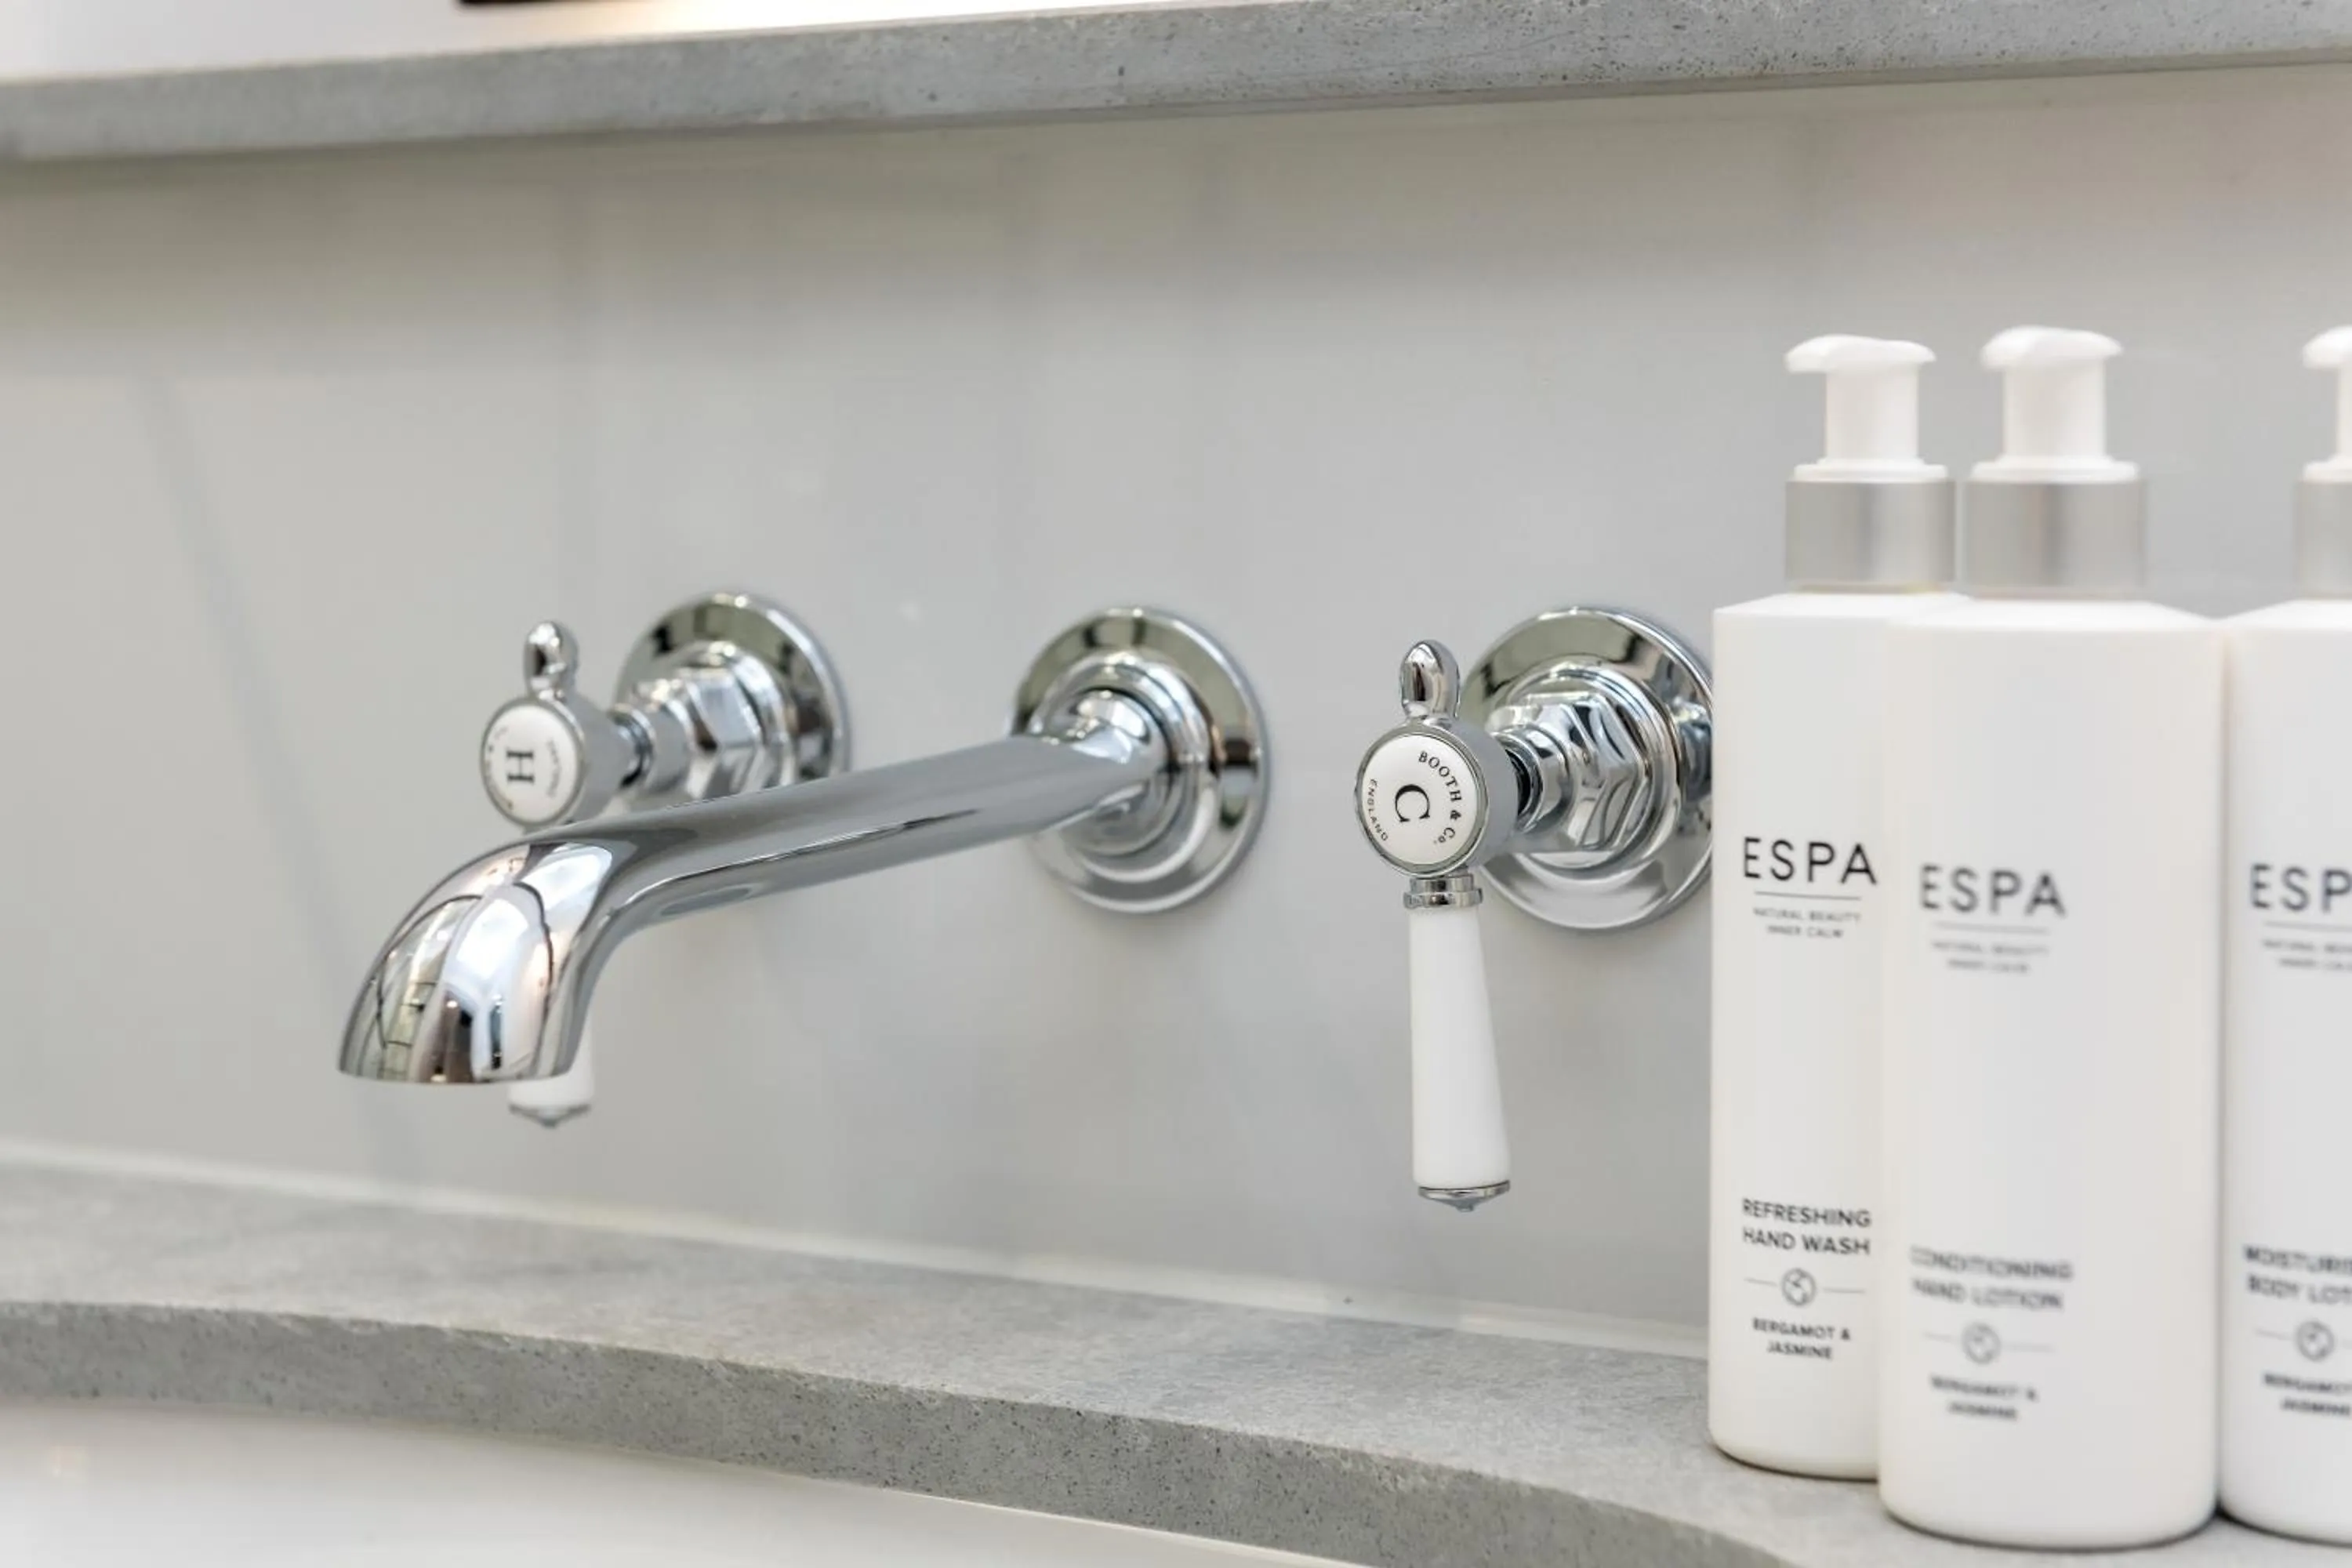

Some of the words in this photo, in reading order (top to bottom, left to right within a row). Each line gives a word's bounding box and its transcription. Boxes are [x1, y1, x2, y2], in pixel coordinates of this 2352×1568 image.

[506, 750, 535, 785] H
[1395, 783, 1430, 823] C
[1418, 750, 1462, 802] BOOTH
[1450, 809, 1462, 821] &
[1367, 778, 1388, 841] ENGLAND
[1743, 836, 1878, 885] ESPA
[1920, 863, 2067, 917] ESPA
[2249, 862, 2352, 915] ESP
[1743, 1198, 1871, 1228] REFRESHING
[1743, 1227, 1796, 1250] HAND
[1802, 1234, 1871, 1254] WASH
[1970, 1286, 2065, 1312] LOTION
[2246, 1273, 2300, 1300] BODY
[1753, 1317, 1835, 1340] BERGAMOT
[1766, 1341, 1833, 1360] JASMINE
